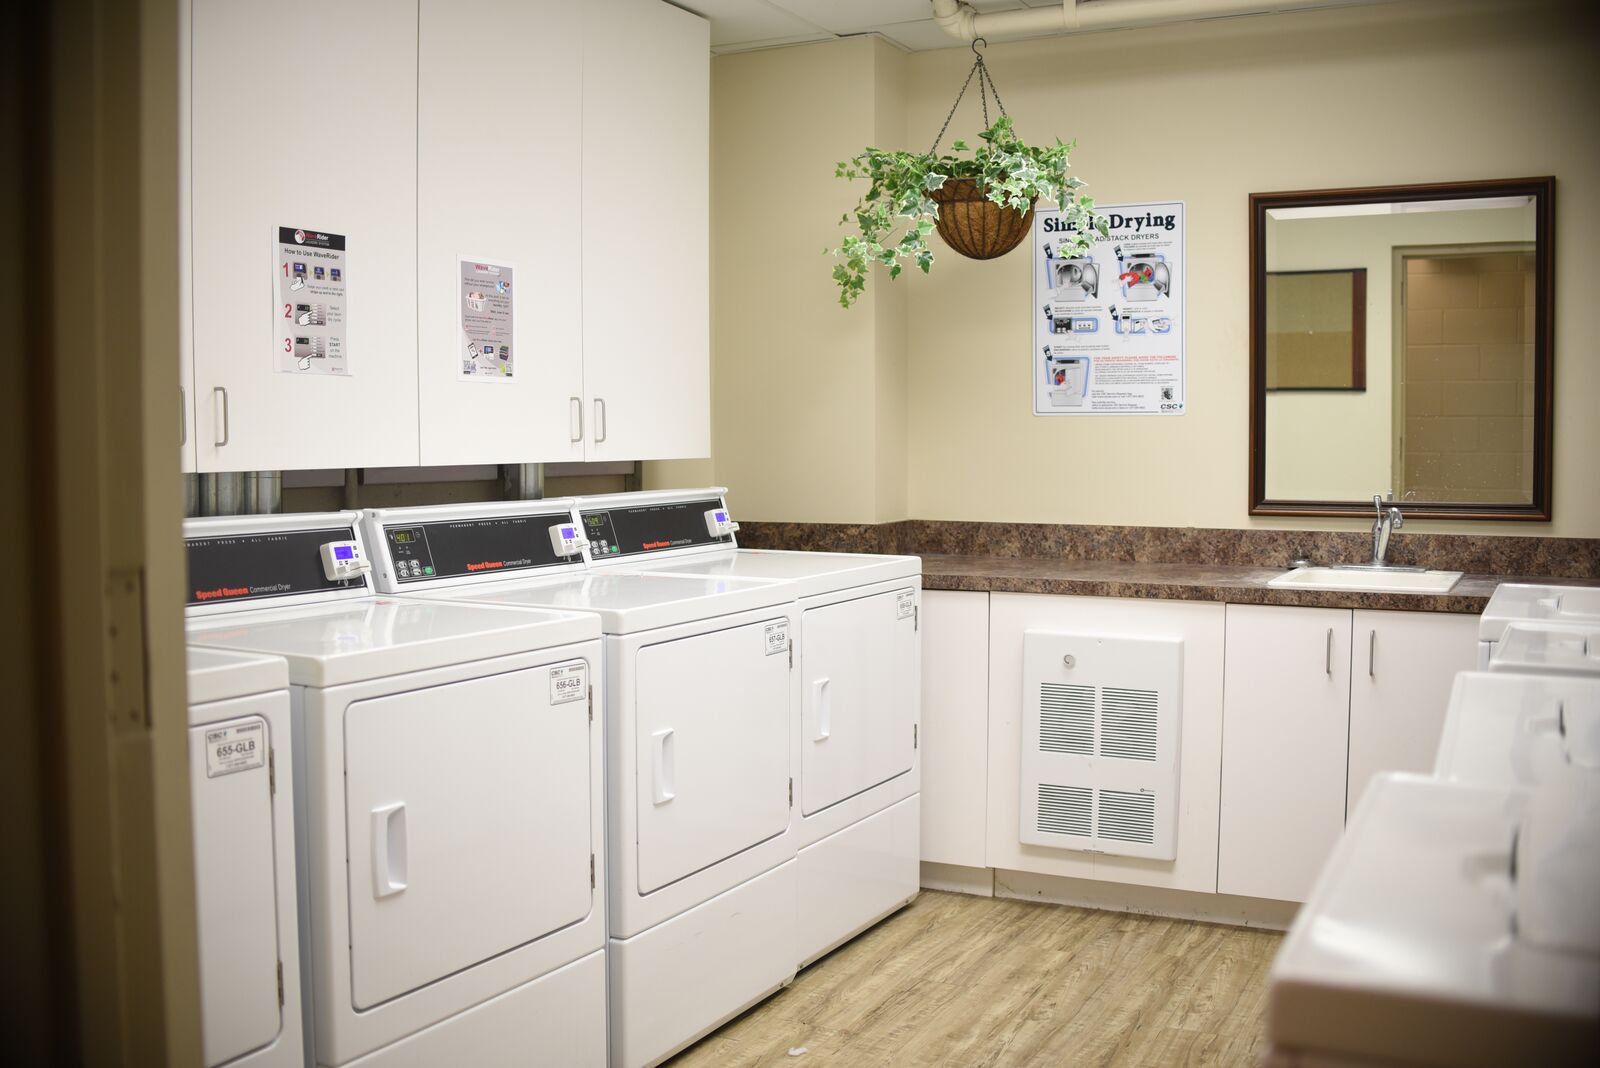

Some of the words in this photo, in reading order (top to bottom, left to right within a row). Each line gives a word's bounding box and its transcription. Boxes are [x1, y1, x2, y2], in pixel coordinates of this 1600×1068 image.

[1043, 215, 1105, 235] Siml
[1109, 212, 1176, 232] Drying
[1131, 233, 1160, 241] DRYERS
[284, 247, 296, 255] How
[313, 252, 340, 260] WaveRider
[283, 261, 289, 278] 1
[284, 303, 292, 319] 2
[284, 337, 292, 353] 3
[642, 542, 657, 550] Speed
[466, 562, 485, 571] Speed
[485, 561, 503, 569] Queen
[195, 588, 223, 600] Speed
[222, 586, 250, 597] Queen
[249, 584, 278, 594] Commercial
[278, 583, 291, 592] Dryer
[556, 678, 581, 690] 656-GLB
[216, 740, 256, 758] 655-GLB
